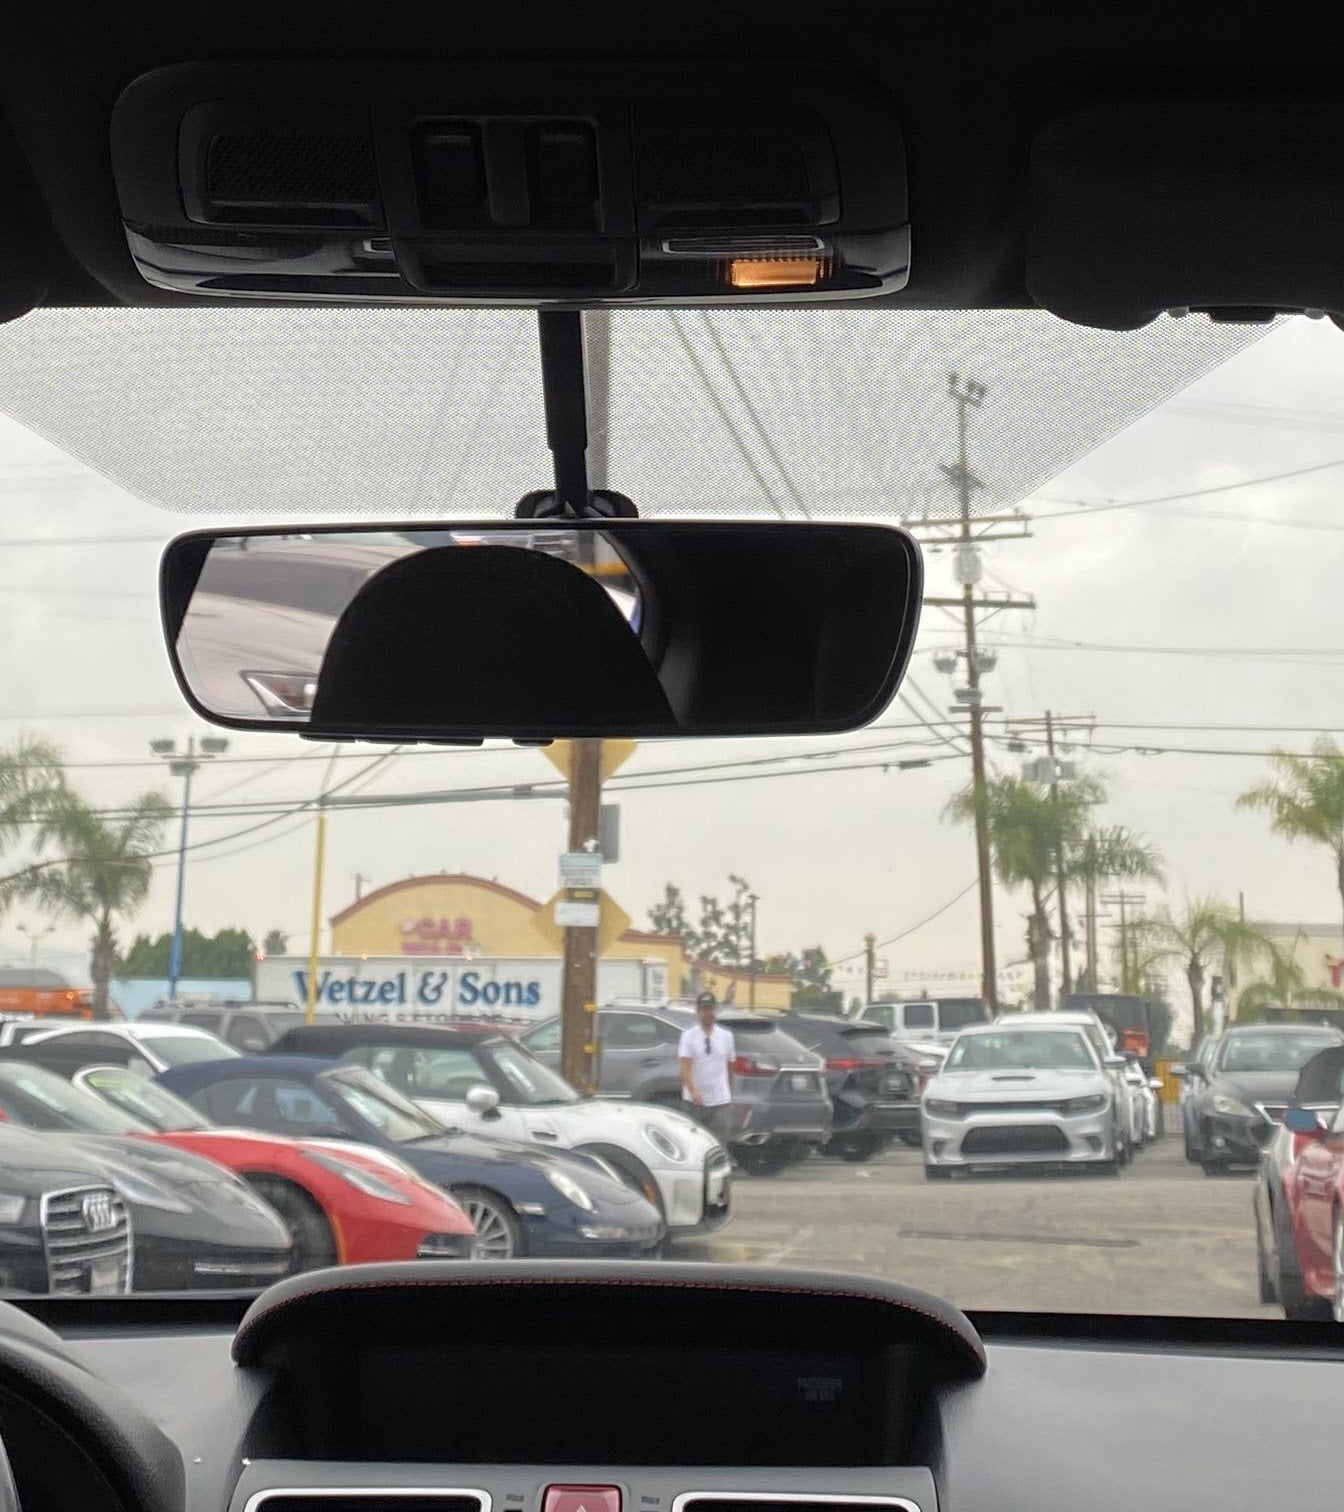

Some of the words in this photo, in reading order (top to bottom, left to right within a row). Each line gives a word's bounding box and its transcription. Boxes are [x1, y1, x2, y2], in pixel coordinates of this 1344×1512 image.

[292, 970, 407, 1006] Wetzel
[417, 970, 448, 1005] &
[458, 970, 542, 1006] Sons
